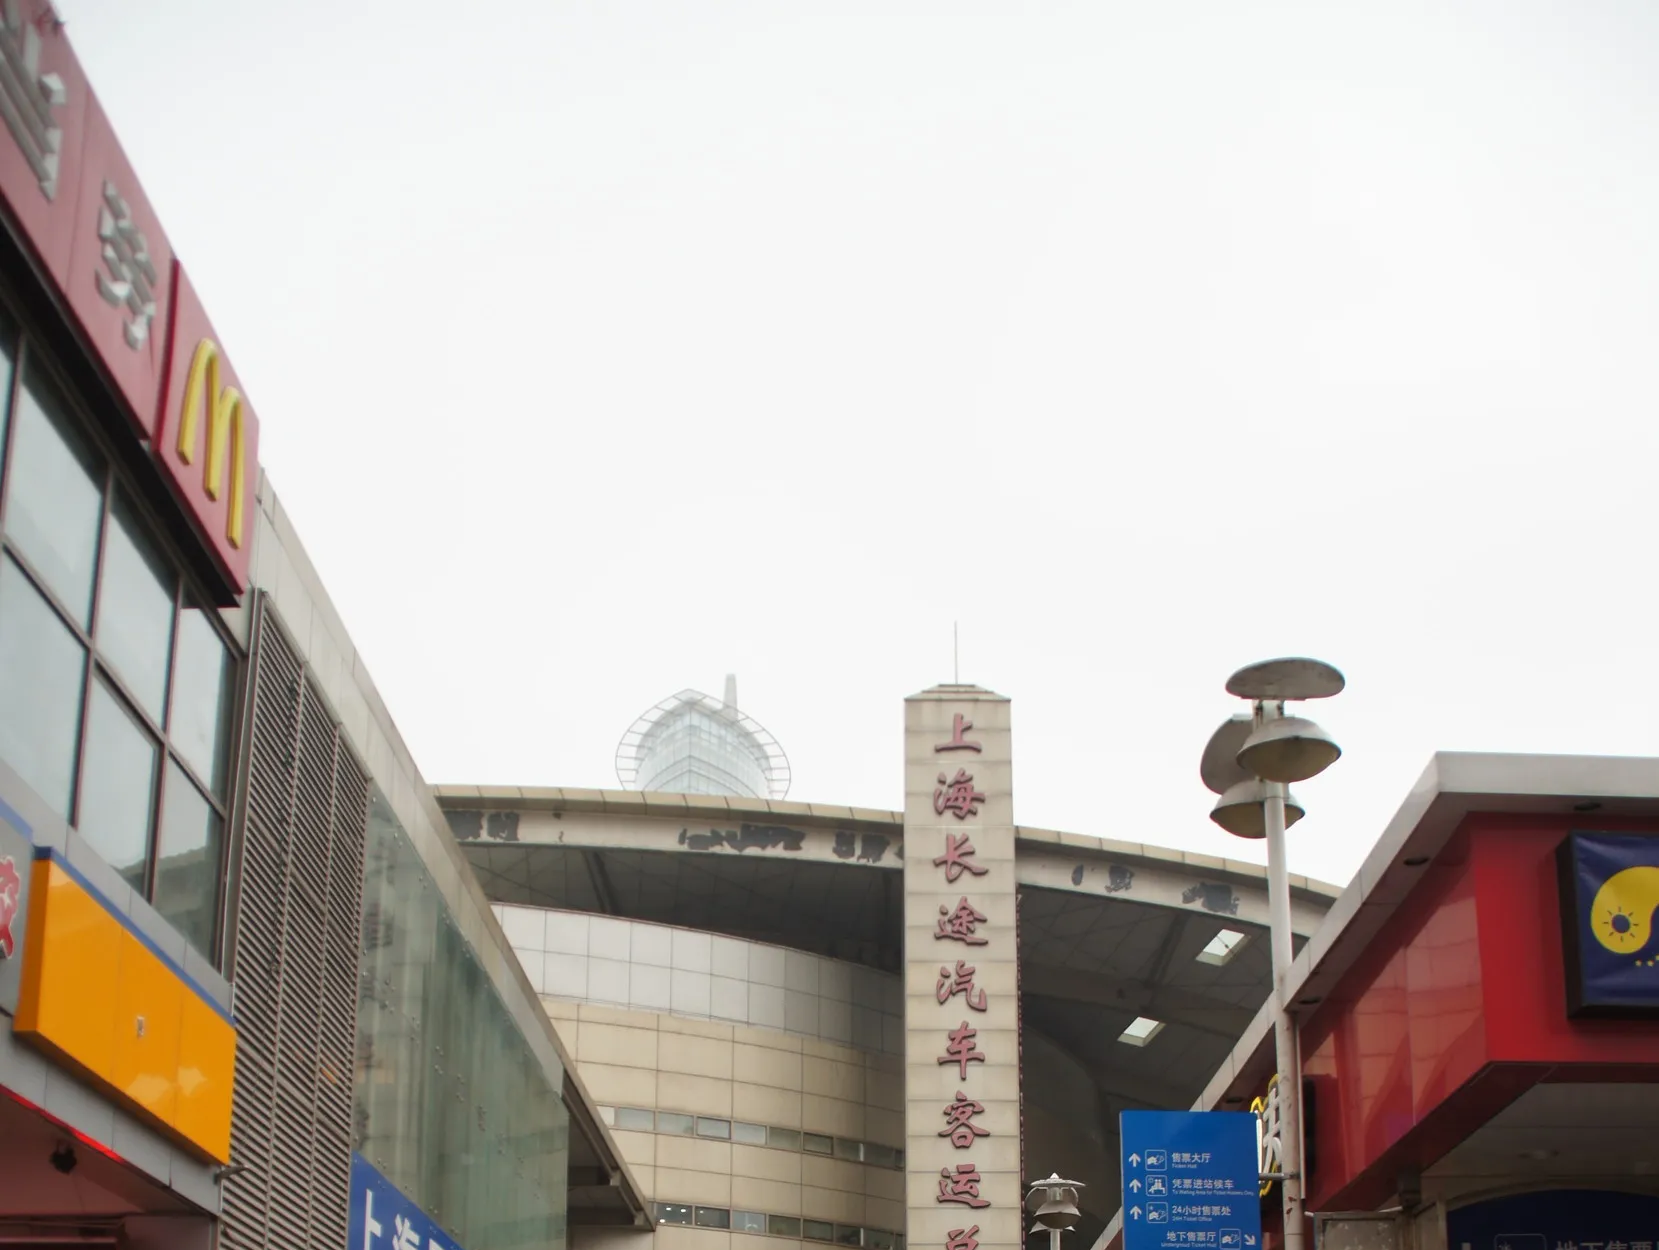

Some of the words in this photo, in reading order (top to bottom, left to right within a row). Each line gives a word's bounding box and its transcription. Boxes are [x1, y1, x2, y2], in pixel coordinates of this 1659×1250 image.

[1172, 1152, 1211, 1163] 售票大厅
[1172, 1178, 1234, 1189] 凭票进站候车
[1172, 1205, 1231, 1216] 24小时售票处
[1167, 1231, 1217, 1242] 地下售票厅
